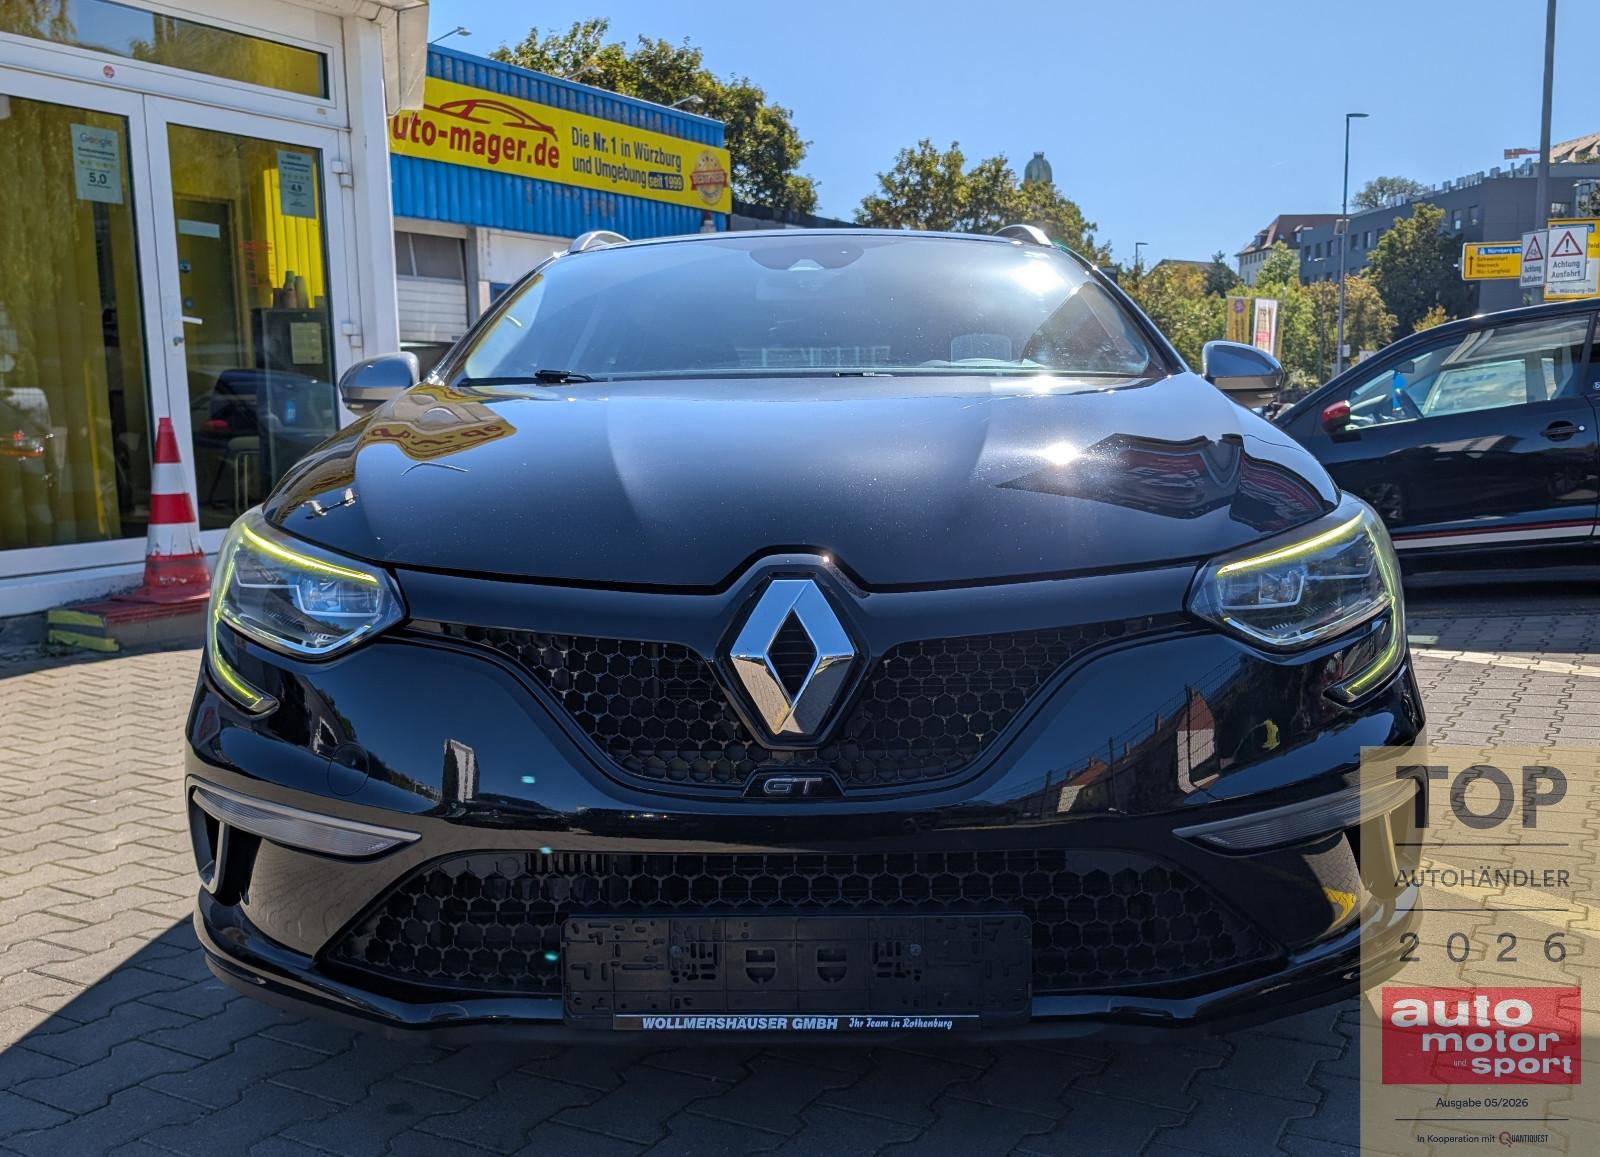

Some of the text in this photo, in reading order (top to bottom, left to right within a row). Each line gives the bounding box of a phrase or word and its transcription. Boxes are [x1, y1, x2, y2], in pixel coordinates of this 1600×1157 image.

[392, 111, 560, 169] uto-mager.de
[571, 126, 682, 173] Die Nr. 1 in Würzburg
[572, 155, 592, 175] und
[594, 157, 646, 189] Umgebung
[649, 175, 663, 189] seit
[664, 175, 683, 190] 1999
[1553, 260, 1580, 269] Achtung
[1552, 270, 1581, 278] Ausfahrt
[763, 777, 822, 794] GT
[642, 1016, 953, 1030] WOLLMERSHÄUSER GMBH Ihr Team in Rothenburg
